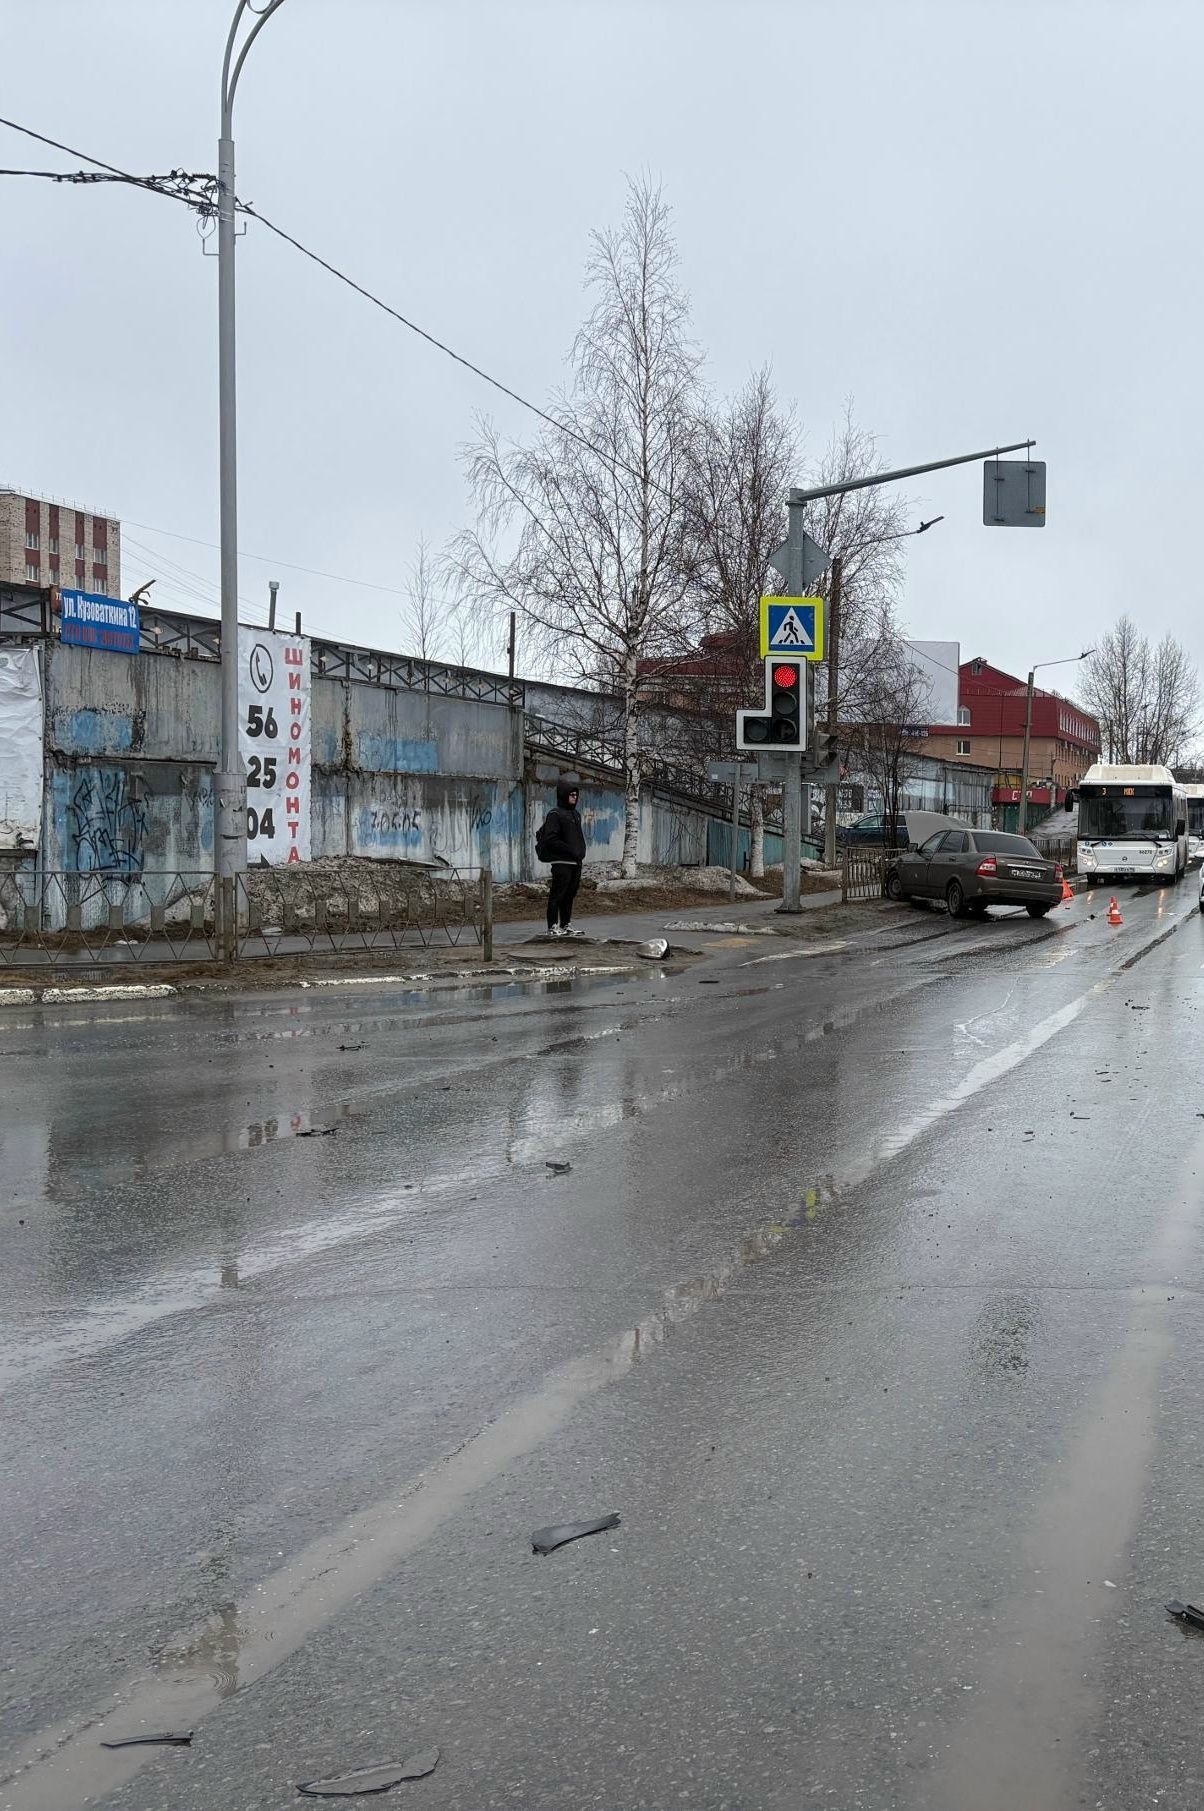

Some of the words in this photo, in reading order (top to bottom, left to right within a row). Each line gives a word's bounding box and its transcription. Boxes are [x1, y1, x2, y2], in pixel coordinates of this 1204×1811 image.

[77, 595, 128, 627] Кузоваткина
[128, 606, 137, 628] 12
[246, 705, 278, 739] 56
[247, 756, 277, 789] 25
[247, 807, 275, 840] 04
